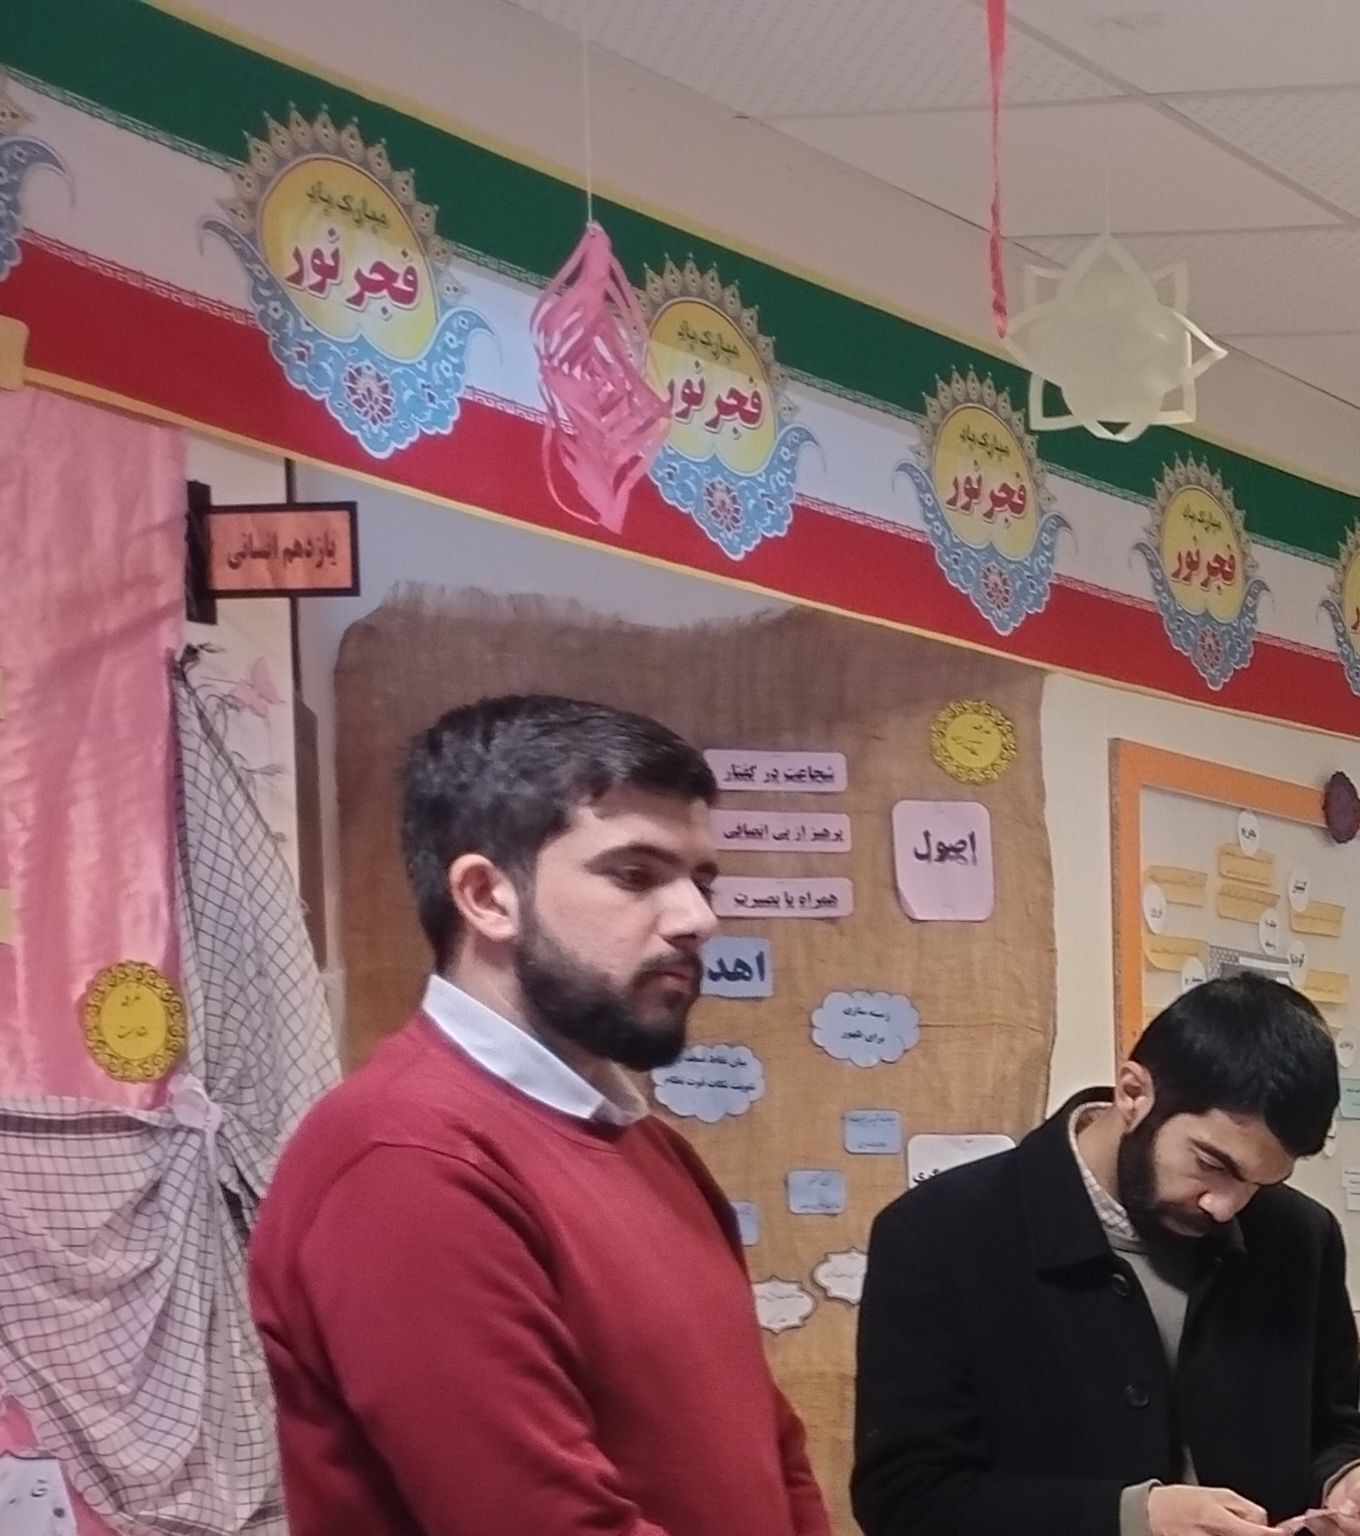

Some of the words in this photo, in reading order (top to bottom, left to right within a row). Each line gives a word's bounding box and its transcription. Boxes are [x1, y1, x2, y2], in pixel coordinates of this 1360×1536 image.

[285, 228, 340, 295] نور
[345, 249, 418, 316] فجر
[667, 360, 706, 420] نور
[705, 376, 762, 436] فجر
[946, 460, 982, 512] نور
[983, 472, 1027, 526] فجر
[227, 531, 278, 570] انسانی
[283, 529, 337, 569] یازدهم
[1170, 536, 1200, 583] نور
[1202, 543, 1236, 596] فجر
[764, 768, 780, 784] در
[914, 829, 977, 864] اصول
[798, 891, 839, 910] همراه
